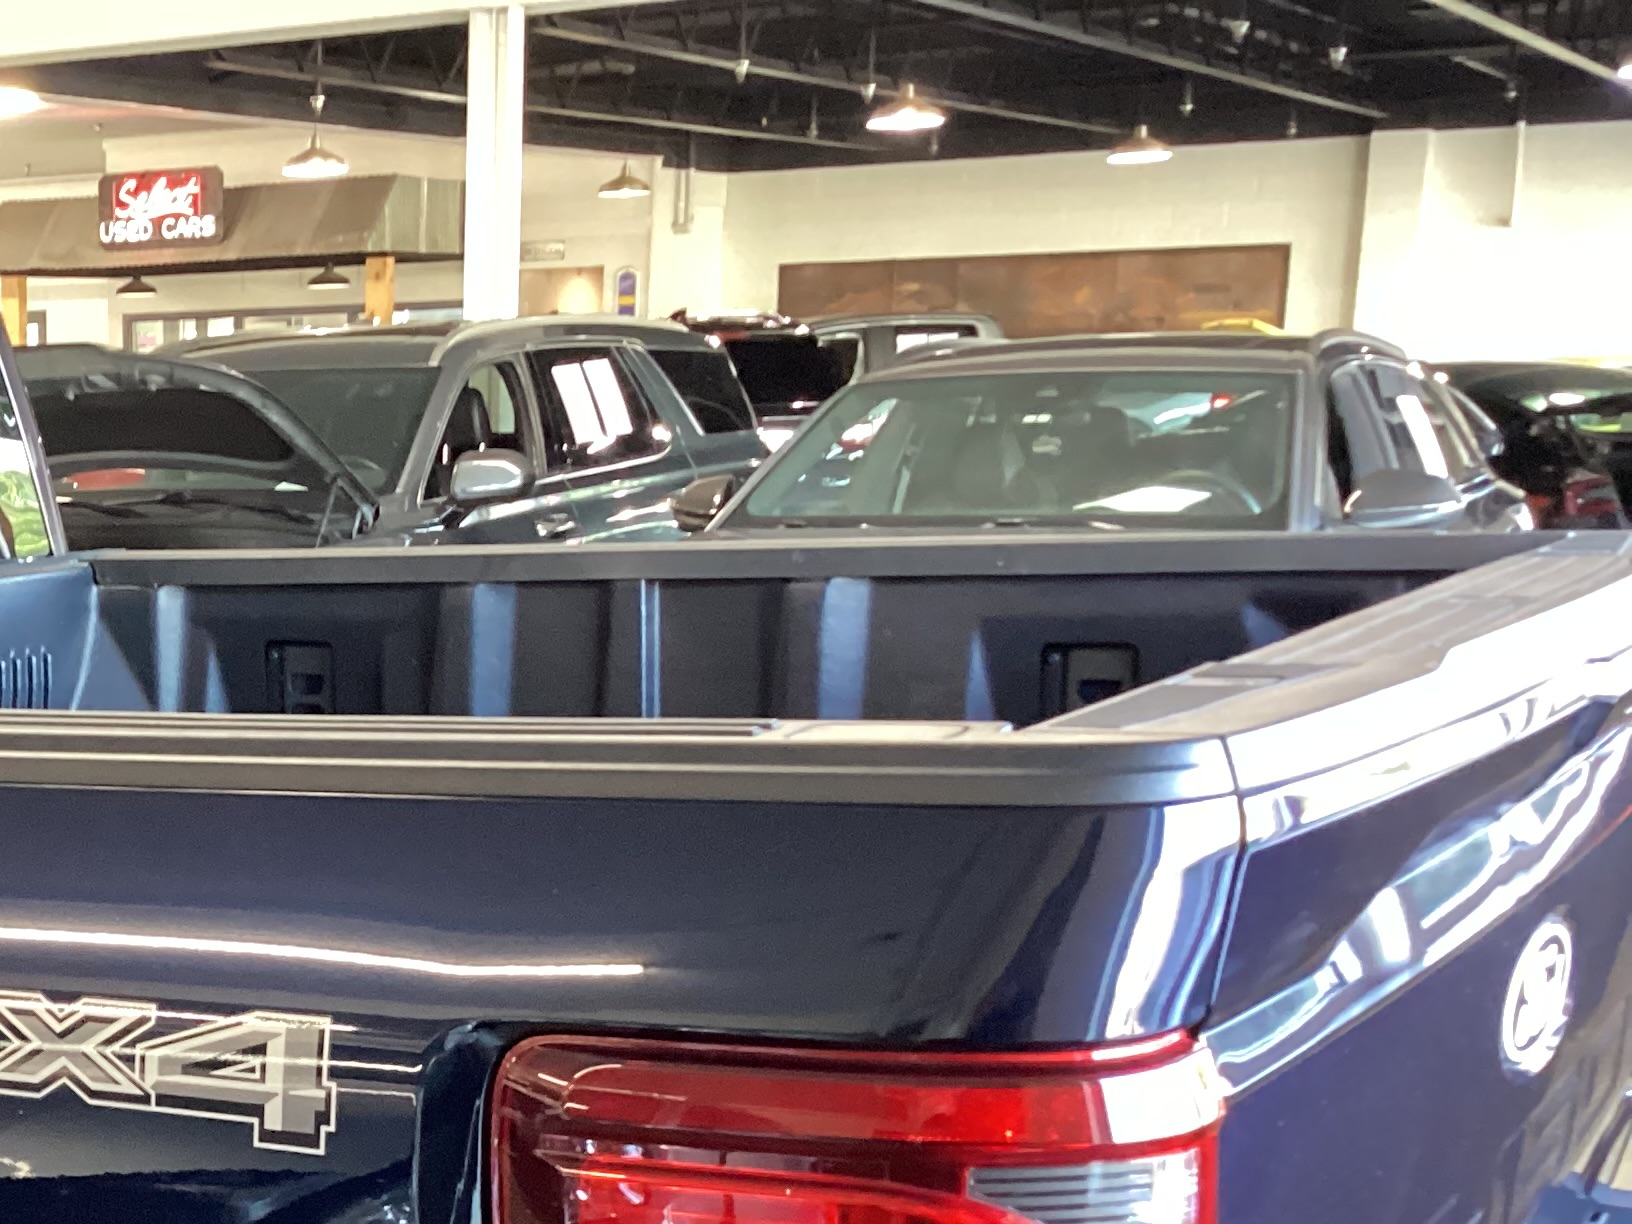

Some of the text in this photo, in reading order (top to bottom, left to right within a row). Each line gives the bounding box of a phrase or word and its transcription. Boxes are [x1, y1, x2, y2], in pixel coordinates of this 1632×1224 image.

[114, 176, 200, 220] Select
[99, 214, 216, 243] USED CARS
